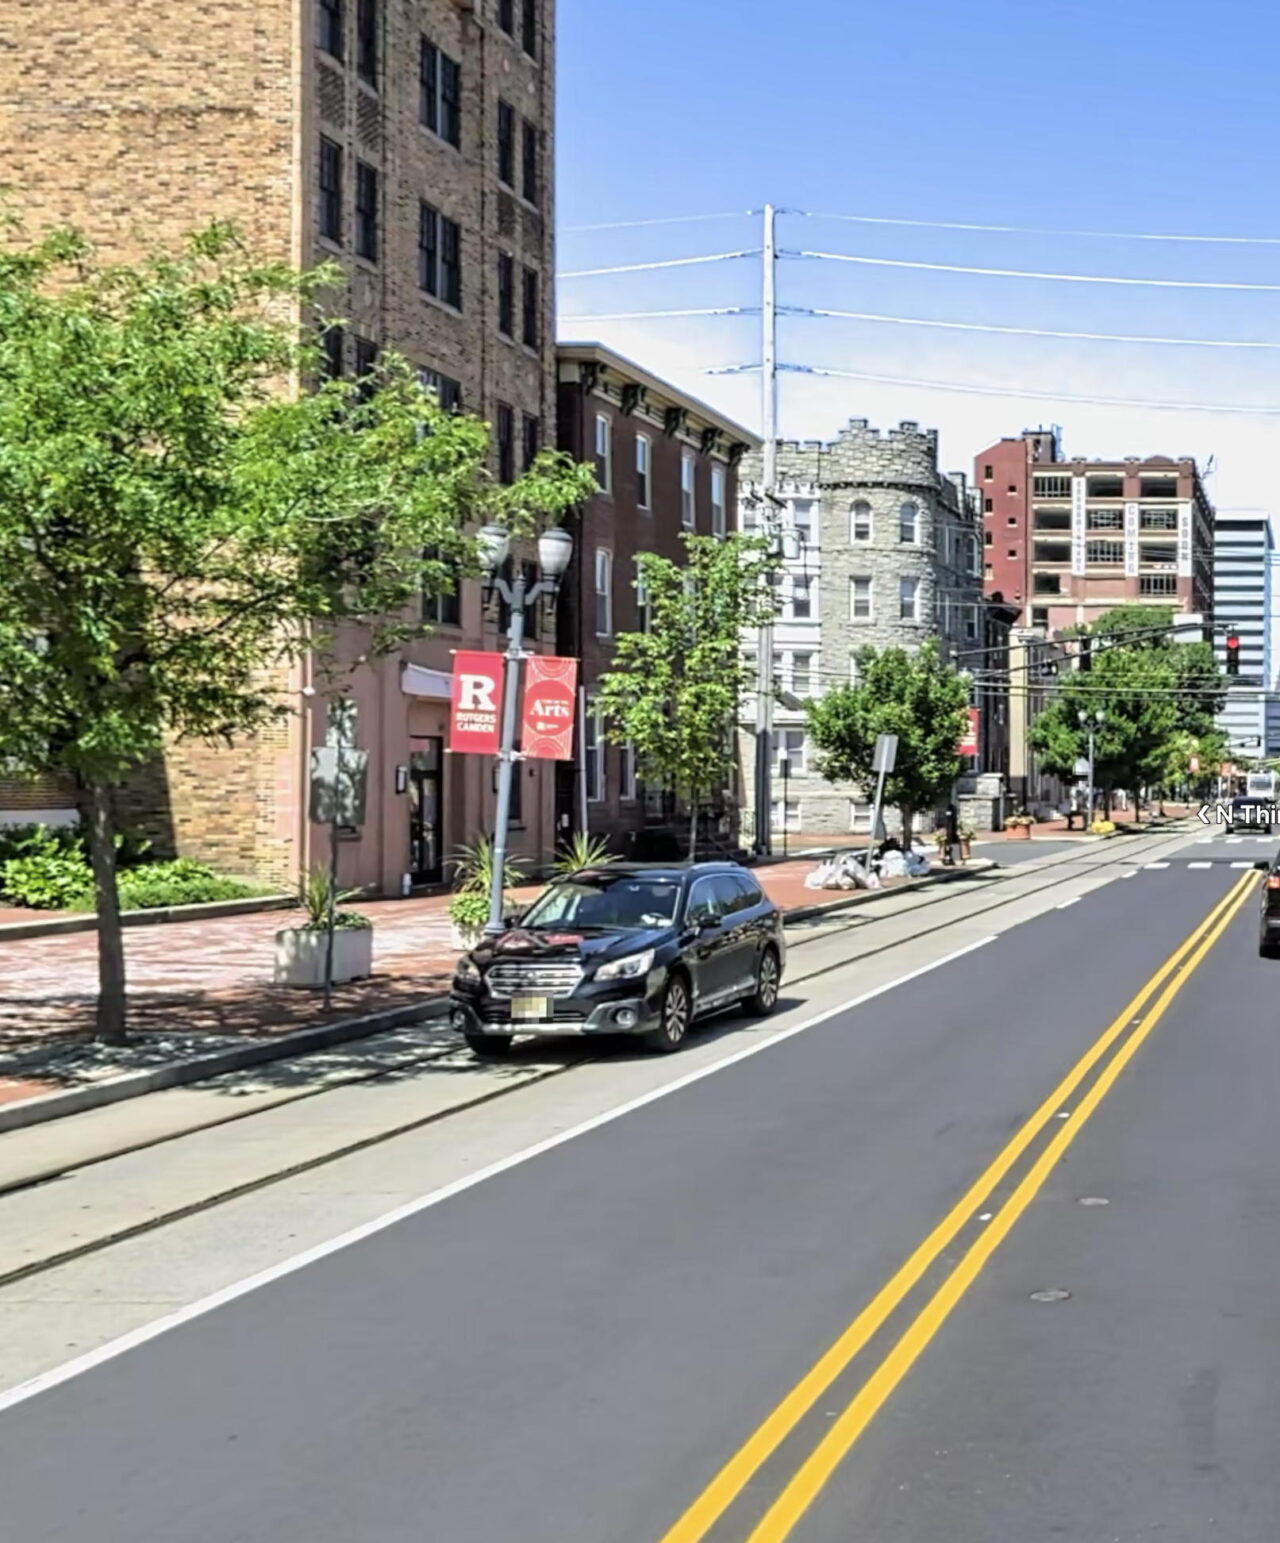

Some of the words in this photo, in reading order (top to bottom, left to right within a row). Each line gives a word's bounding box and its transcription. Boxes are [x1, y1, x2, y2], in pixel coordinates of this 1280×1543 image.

[1181, 517, 1189, 561] SOON
[457, 674, 497, 711] R
[455, 712, 497, 724] RUTGERS
[529, 699, 570, 718] Arts
[456, 722, 495, 734] CAMDEN
